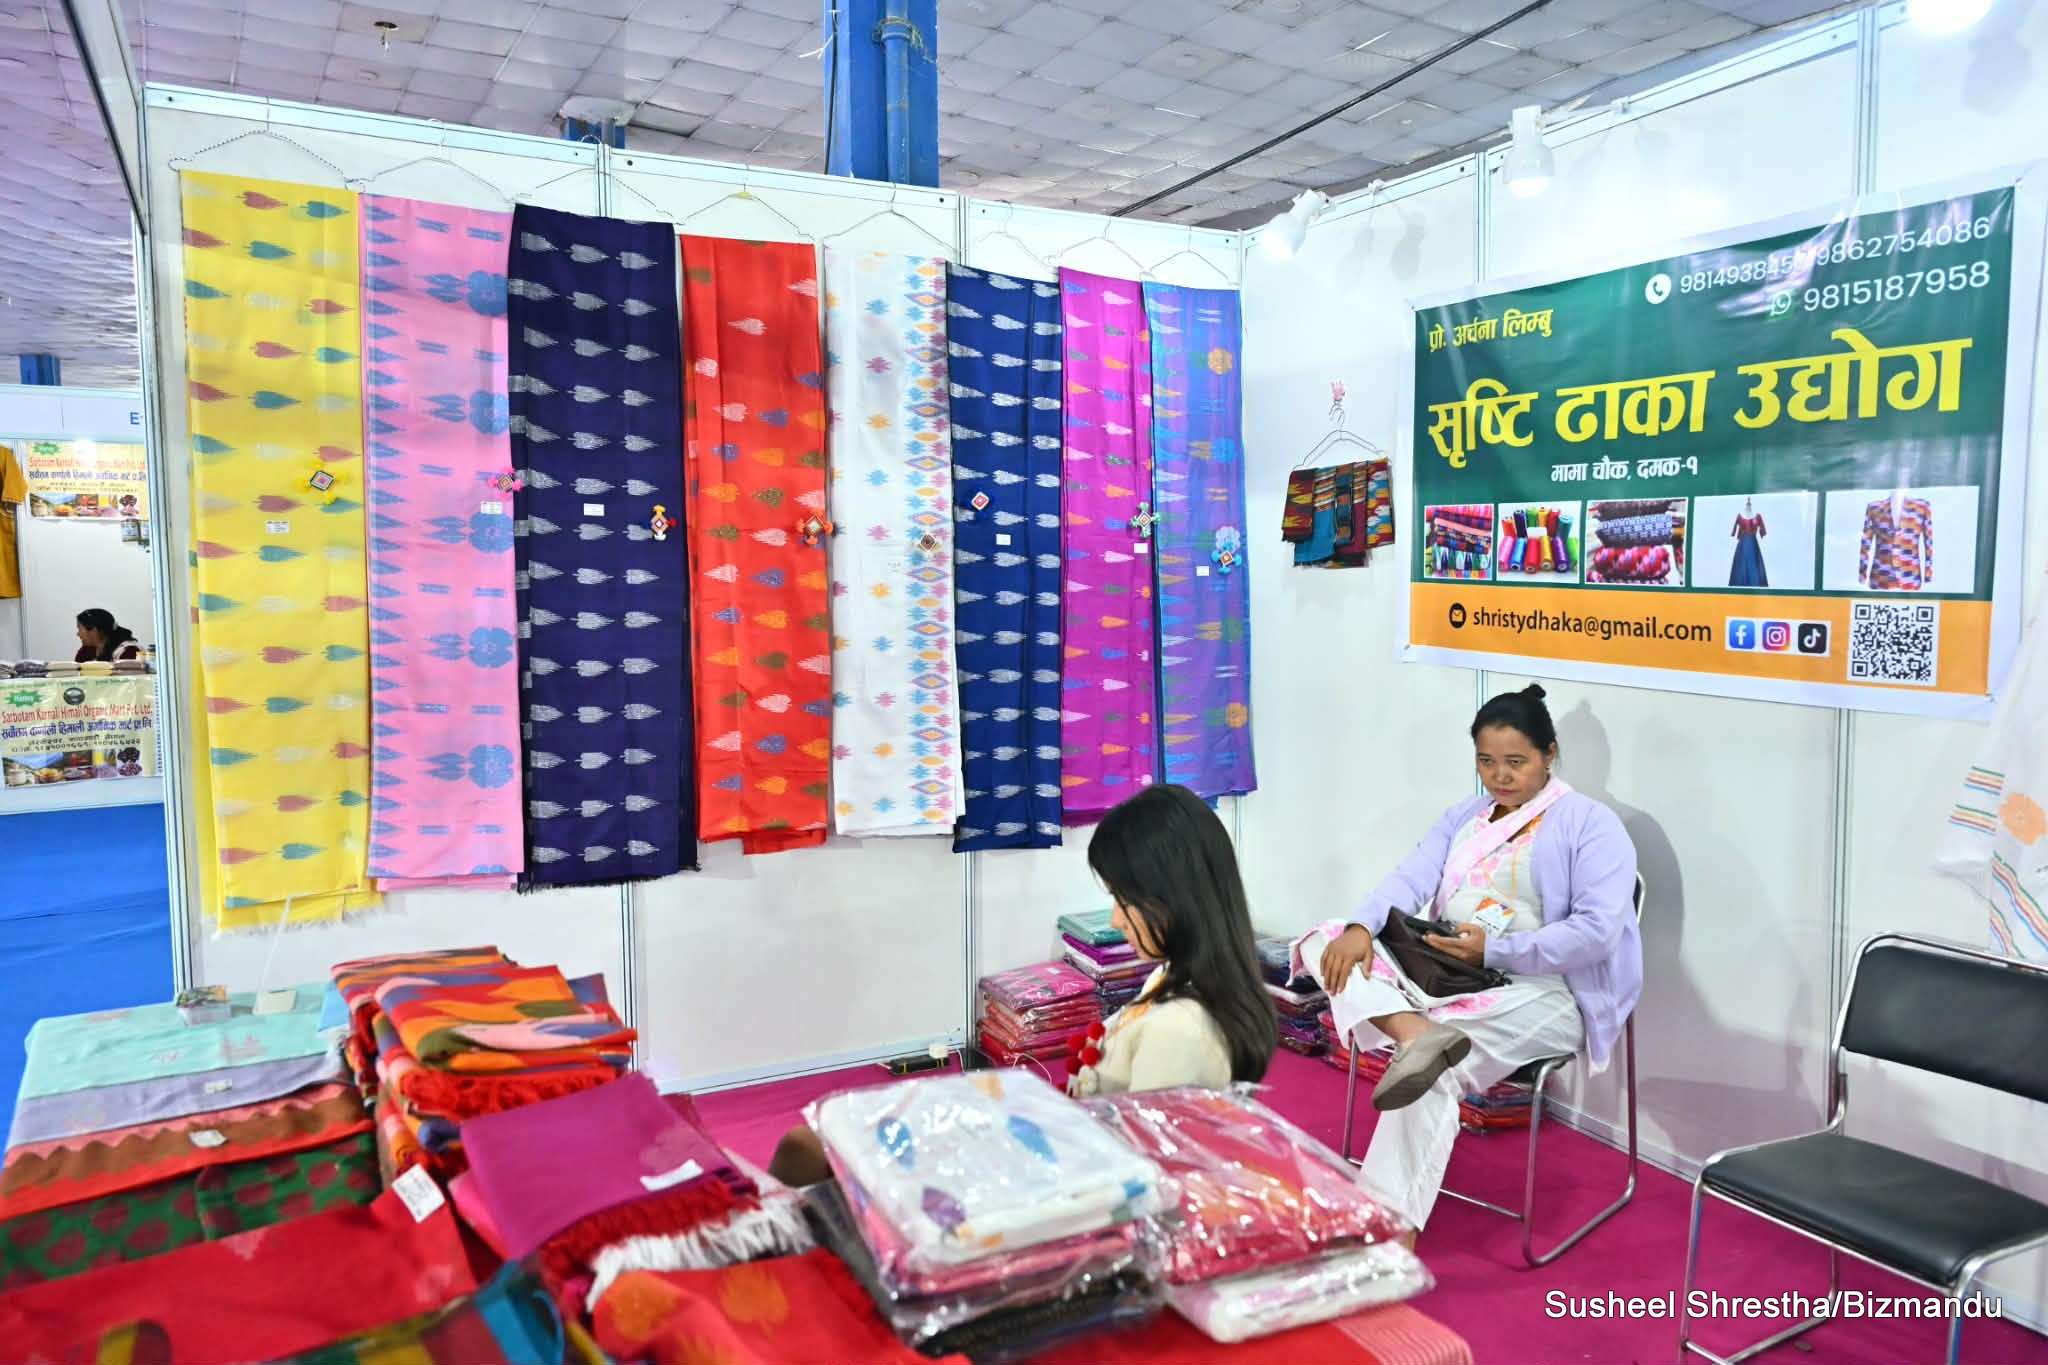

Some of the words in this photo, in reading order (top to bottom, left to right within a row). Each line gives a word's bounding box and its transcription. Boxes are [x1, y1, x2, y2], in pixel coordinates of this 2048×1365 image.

[1680, 249, 1809, 294] 981493845
[1816, 217, 1991, 266] 9862754086
[1803, 261, 1991, 312] 9815187958
[1452, 317, 1498, 347] अर्चना
[1503, 308, 1554, 337] लिम्बु
[1428, 377, 1539, 469] सृष्टि
[1554, 370, 1716, 443] ढाका
[1733, 328, 1973, 428] उद्योग
[1551, 463, 1588, 482] मामा
[1637, 455, 1698, 479] दमक-१
[1473, 609, 1712, 643] shristydhaka@gmail.com
